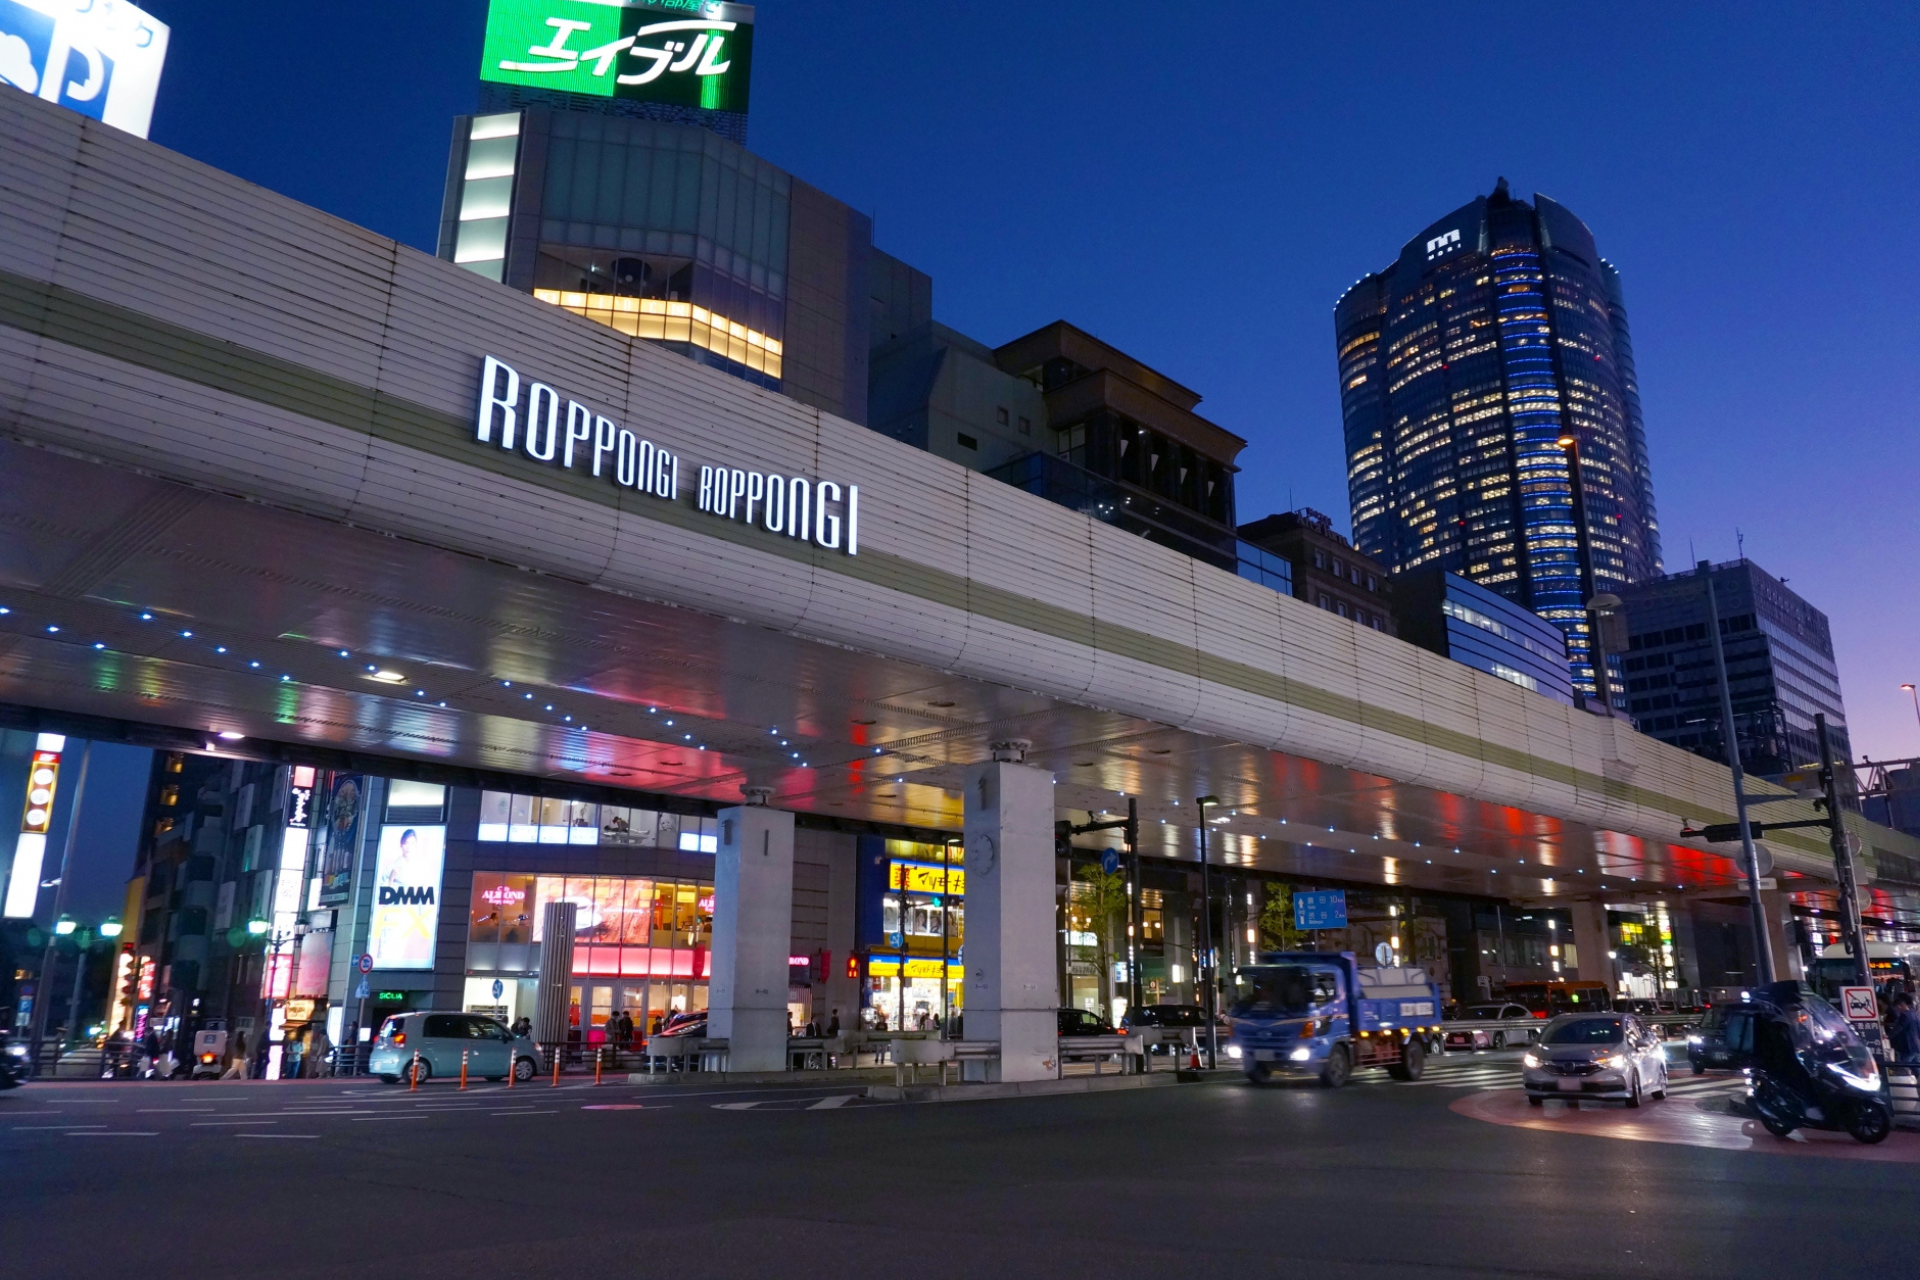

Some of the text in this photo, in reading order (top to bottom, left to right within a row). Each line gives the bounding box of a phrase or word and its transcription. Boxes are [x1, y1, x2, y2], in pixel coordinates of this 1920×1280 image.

[499, 17, 737, 85] エイブル
[1428, 244, 1461, 260] MORI
[477, 354, 859, 556] ROPPONGI ROPPONGI
[379, 886, 434, 905] DMM
[373, 908, 432, 938] FX
